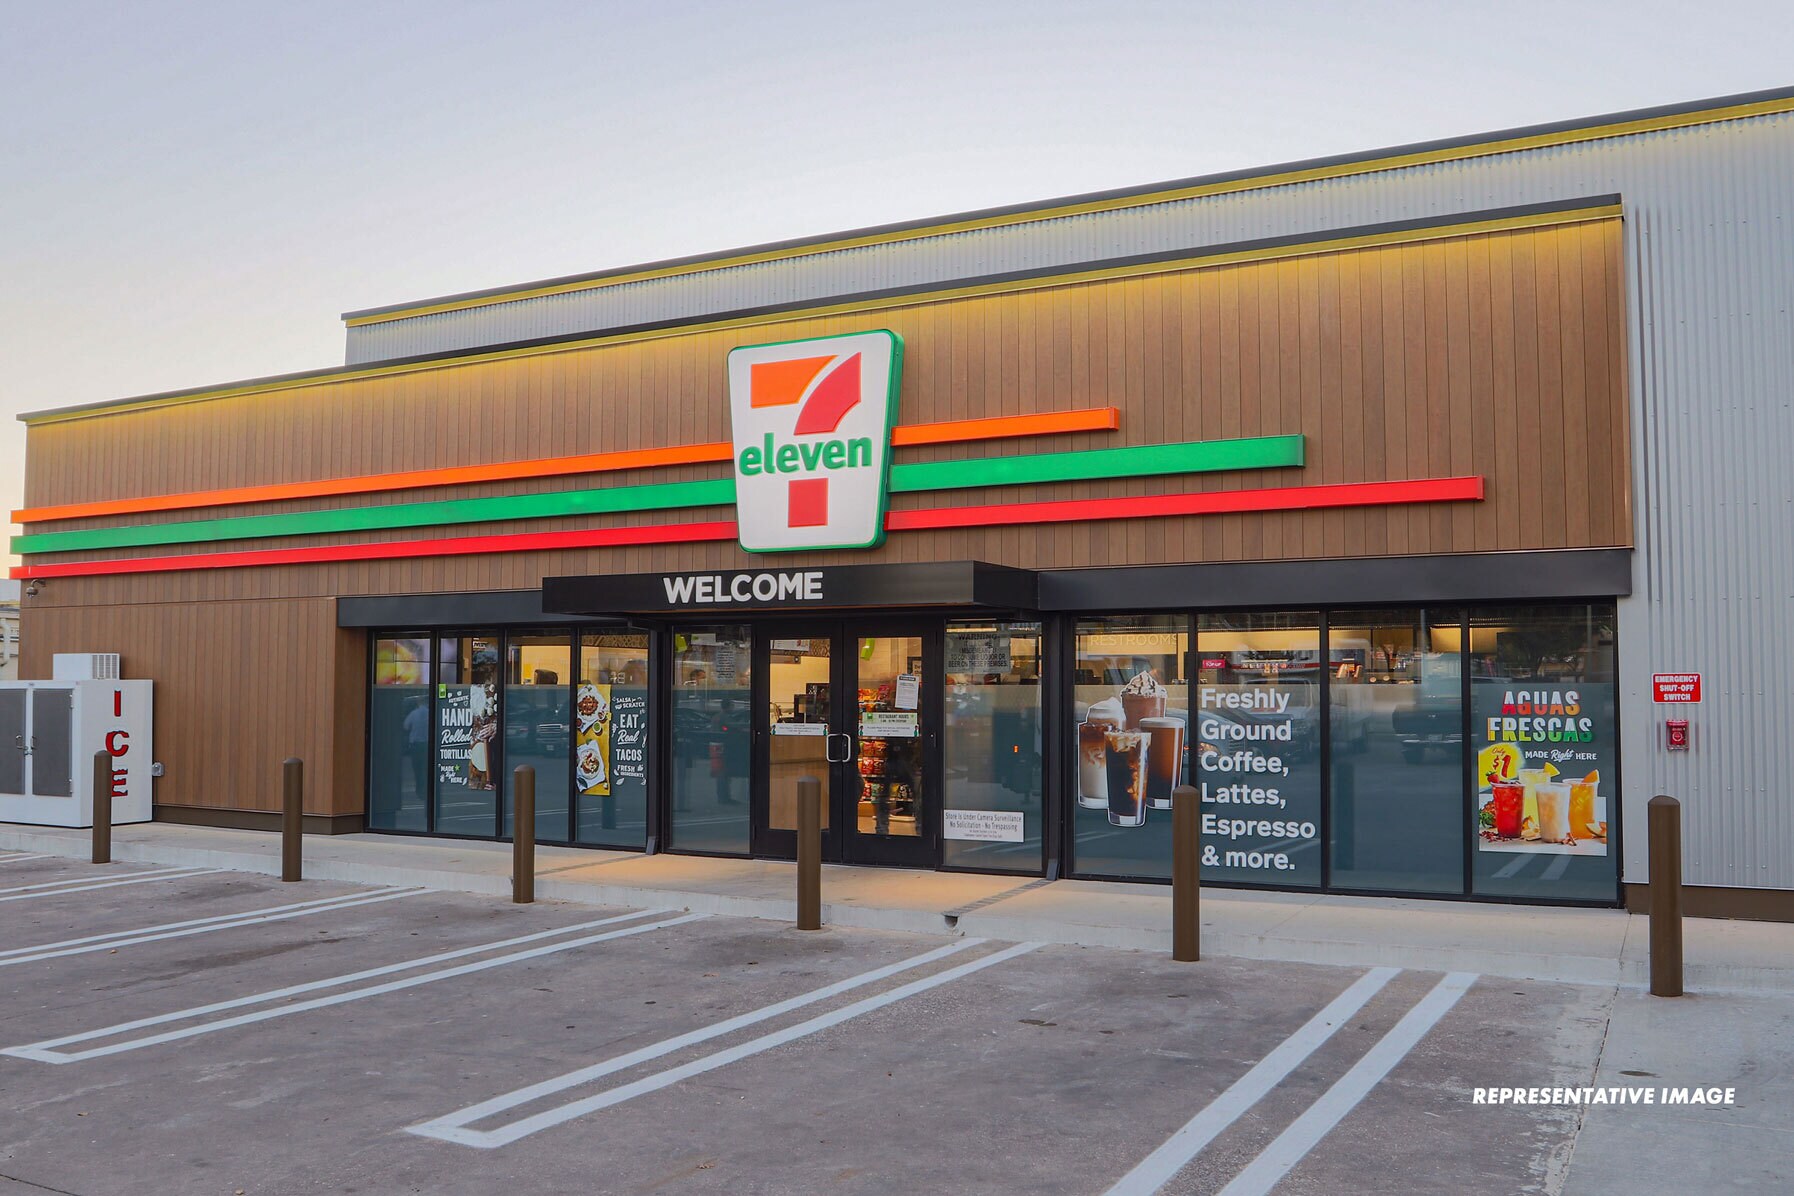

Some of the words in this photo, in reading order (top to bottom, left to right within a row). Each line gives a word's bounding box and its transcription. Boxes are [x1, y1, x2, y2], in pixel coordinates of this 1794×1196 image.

[751, 352, 861, 528] 7
[739, 432, 872, 476] eleven
[662, 572, 823, 604] WELCOME
[1660, 684, 1694, 692] SHUT-OFF
[1664, 693, 1690, 701] SWITCH
[1201, 687, 1290, 713] Freshly
[1501, 690, 1580, 716] AGUAS
[441, 708, 473, 727] HAND
[620, 713, 639, 729] EAT
[441, 727, 473, 744] Rolled
[618, 729, 640, 743] Real
[1200, 719, 1292, 742] Ground
[1487, 717, 1593, 743] FRESCAS
[105, 690, 130, 798] ICE
[440, 749, 472, 760] TORTILLAS
[616, 749, 642, 761] TACOS
[1525, 750, 1549, 759] MADE
[1550, 748, 1574, 762] Right
[1575, 752, 1597, 760] HERE
[617, 764, 635, 772] FRESH
[1201, 751, 1289, 776] Coffee,
[1492, 754, 1512, 778] $1
[1201, 782, 1286, 809] Lattes,
[992, 823, 1017, 832] Trespassing
[1201, 814, 1316, 840] Espresso
[1201, 845, 1220, 868] &
[1226, 851, 1296, 870] more.
